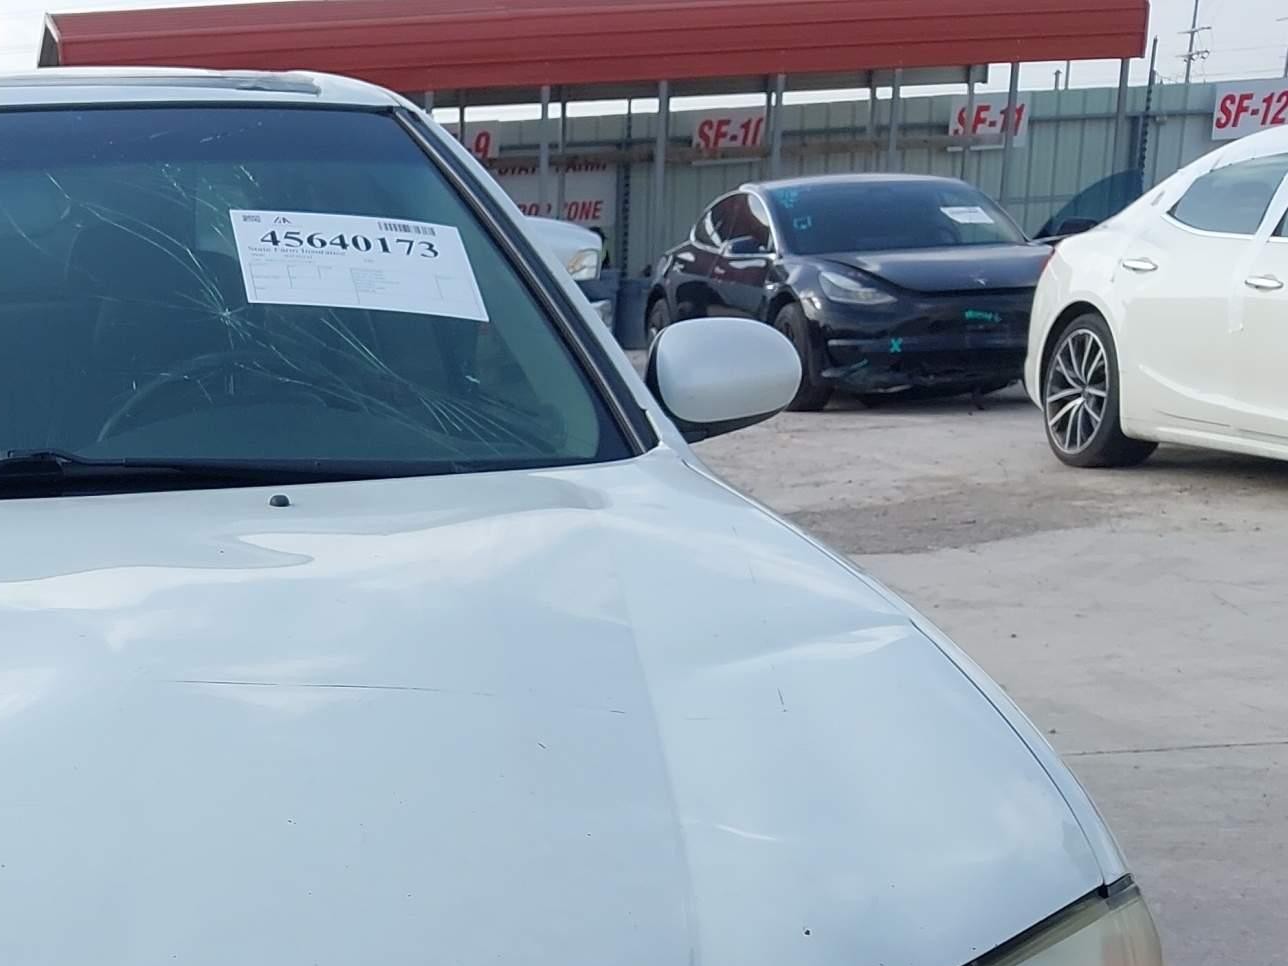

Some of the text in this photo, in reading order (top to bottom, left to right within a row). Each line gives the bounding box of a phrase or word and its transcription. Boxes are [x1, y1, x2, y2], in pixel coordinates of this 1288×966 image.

[1215, 90, 1288, 129] SF-12
[565, 200, 604, 220] ONE
[260, 230, 439, 258] 45640173
